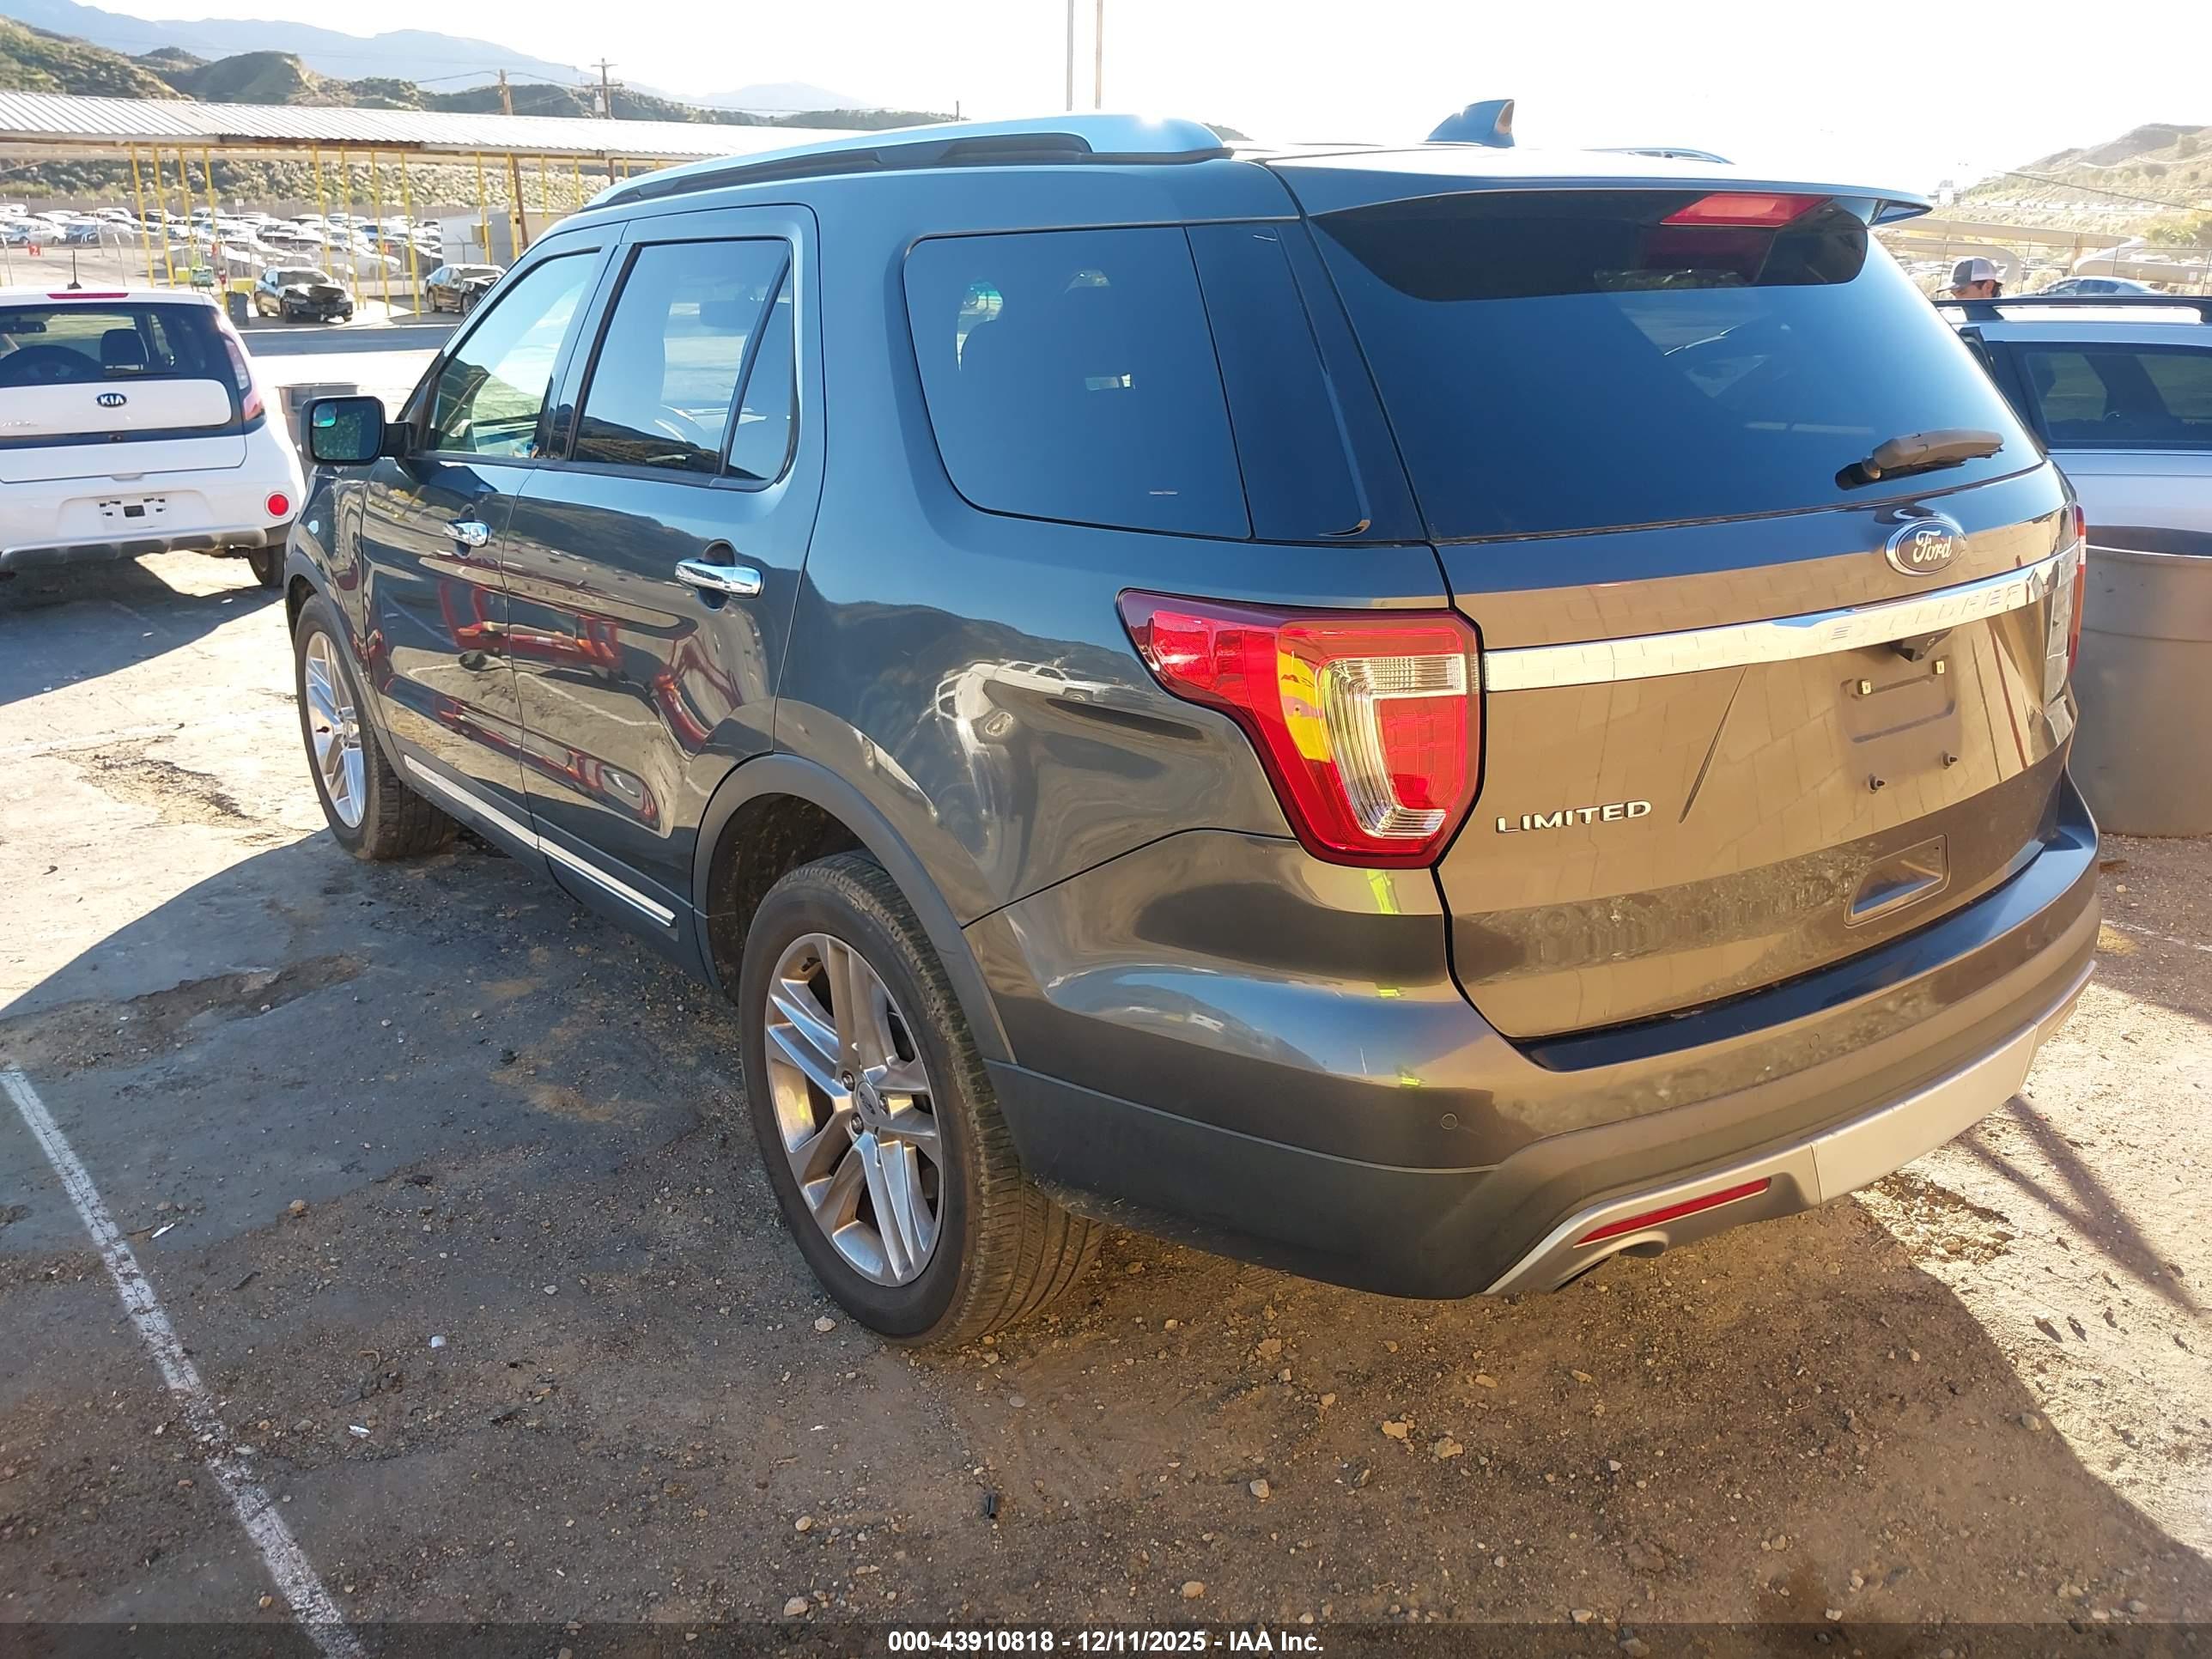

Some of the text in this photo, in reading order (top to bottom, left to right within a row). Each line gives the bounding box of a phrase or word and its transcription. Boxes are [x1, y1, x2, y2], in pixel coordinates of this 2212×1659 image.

[100, 395, 125, 405] KIA
[1913, 530, 1953, 563] Ford
[1495, 800, 1651, 834] LIMITED
